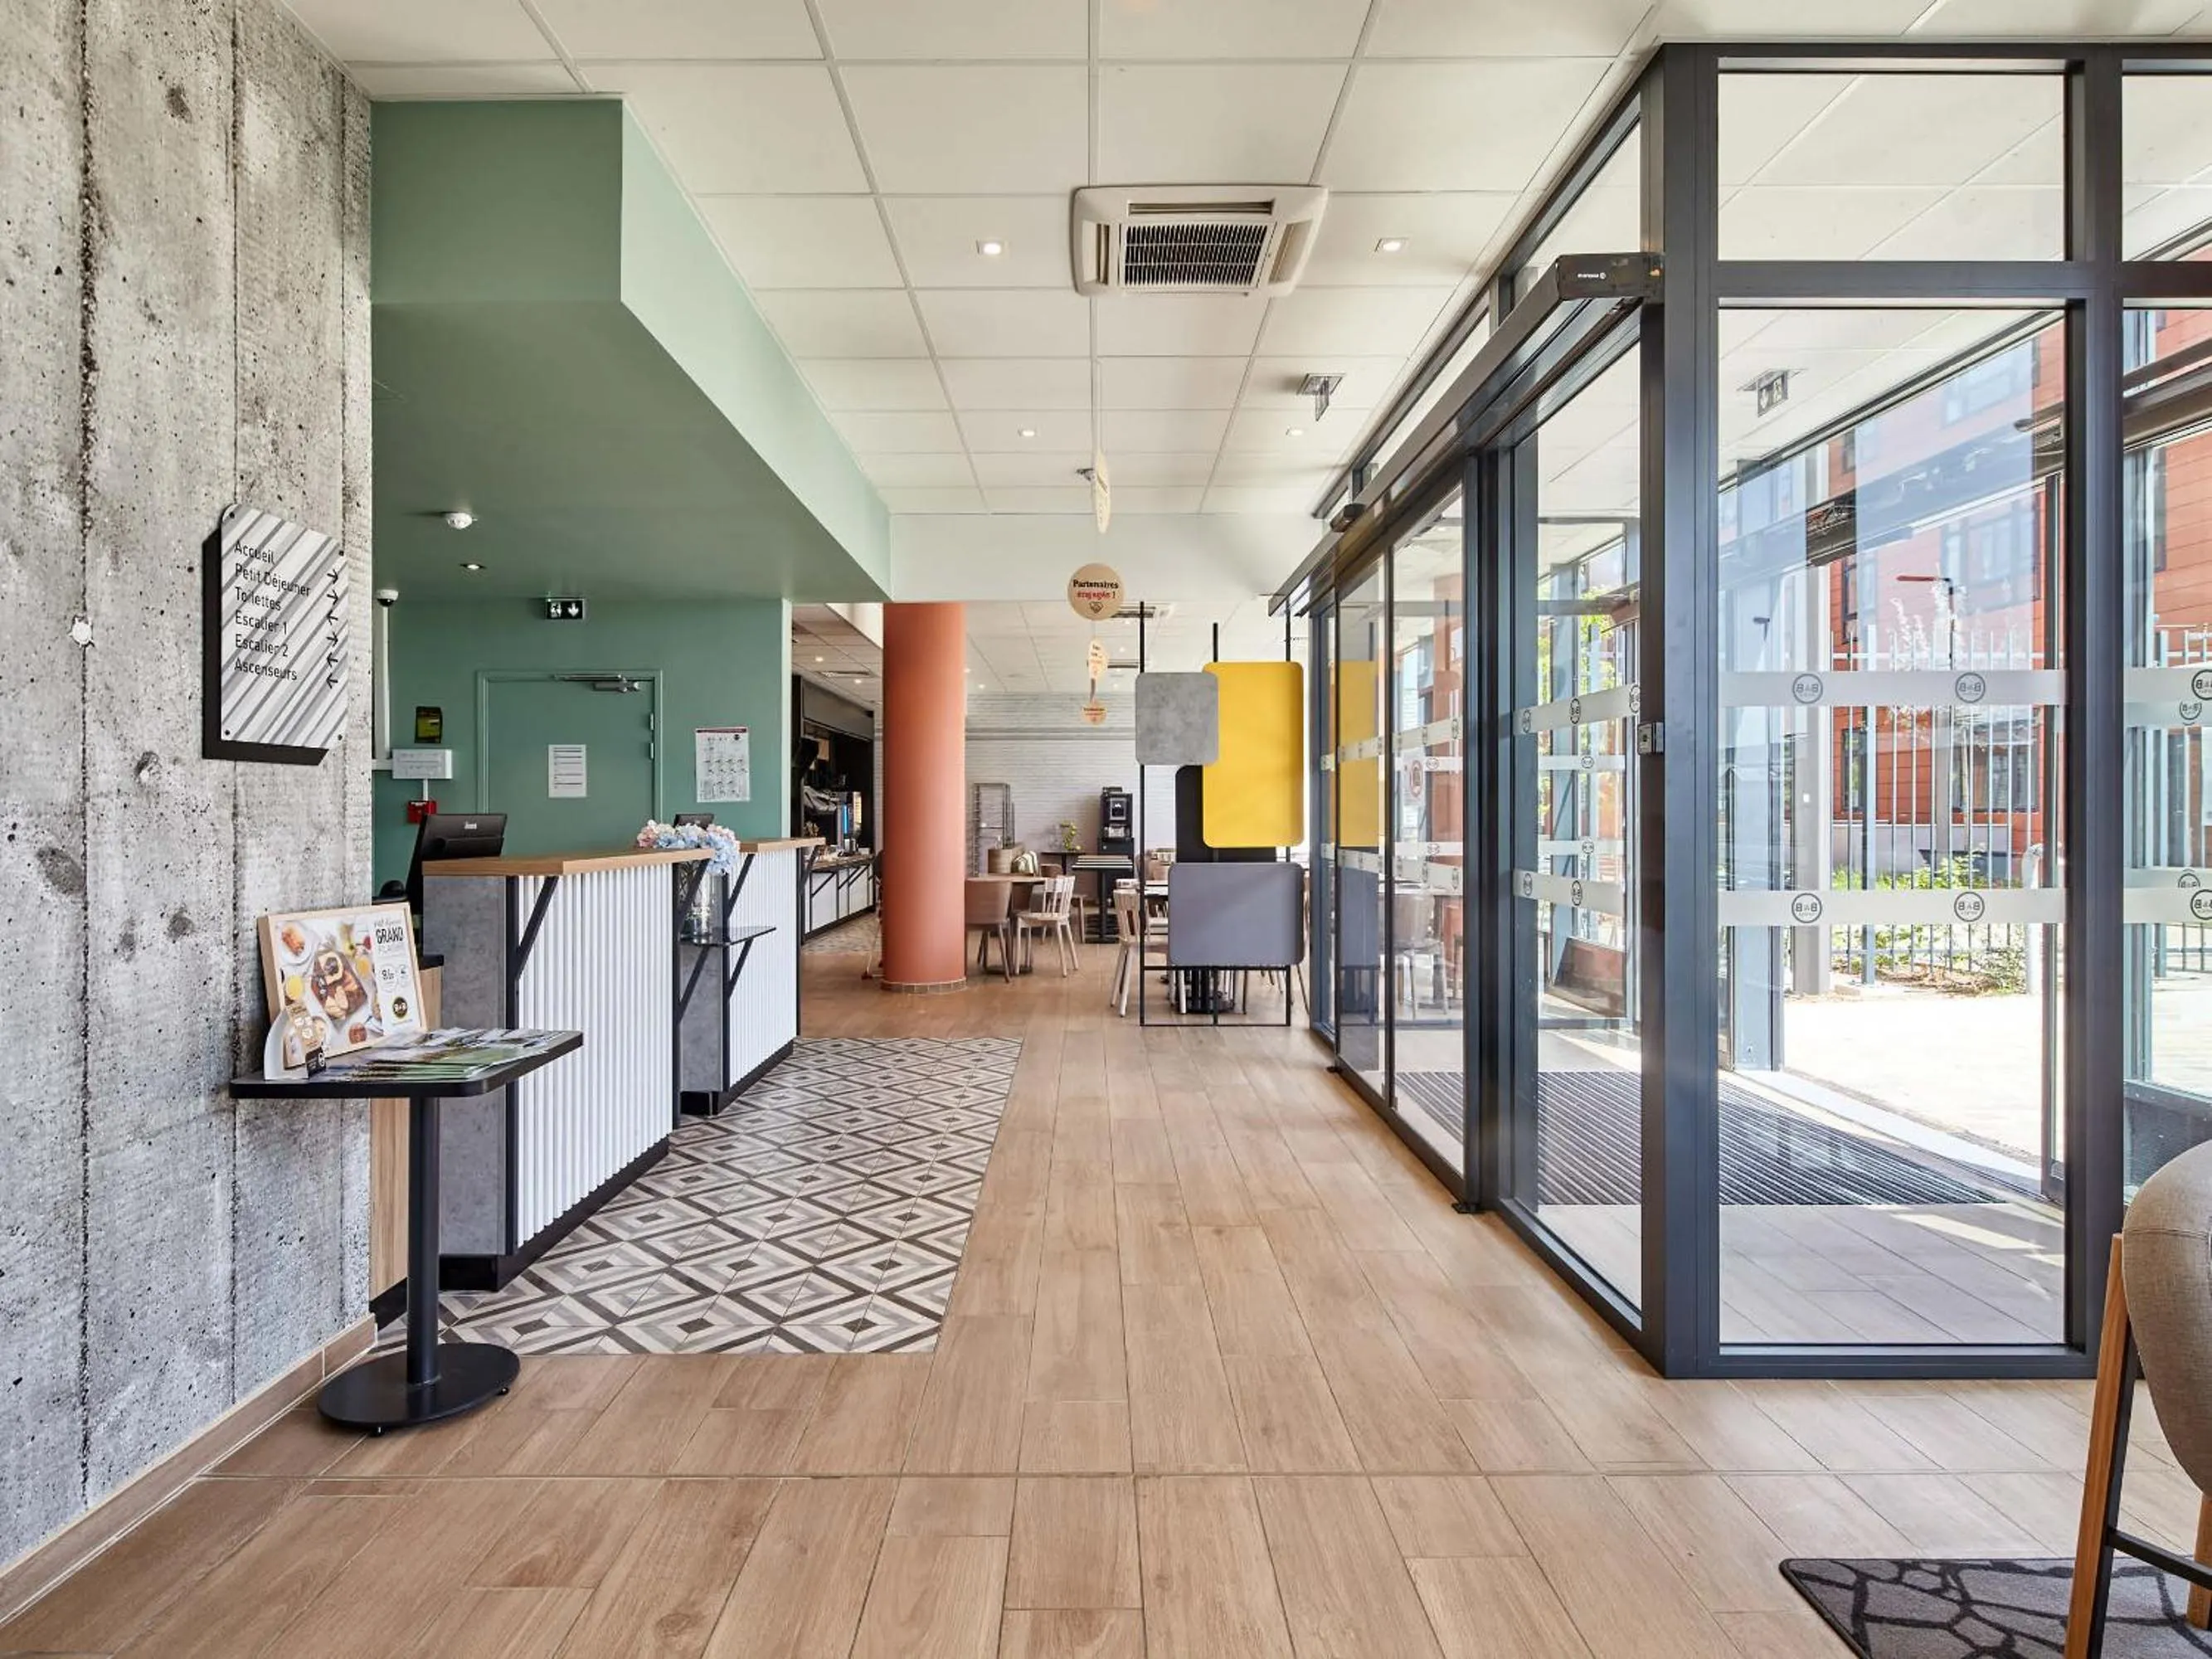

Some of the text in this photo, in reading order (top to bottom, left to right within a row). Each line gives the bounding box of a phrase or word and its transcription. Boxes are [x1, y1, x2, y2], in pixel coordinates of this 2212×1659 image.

[234, 539, 275, 565] Accueil
[235, 562, 311, 596] Petit Déjeuner
[1072, 579, 1119, 589] Partenaires
[235, 586, 282, 611] Toilettes
[235, 609, 288, 635] Escalier 1
[235, 633, 289, 658] Escalier 2
[234, 657, 298, 681] Ascenseurs
[375, 926, 404, 945] GRAND
